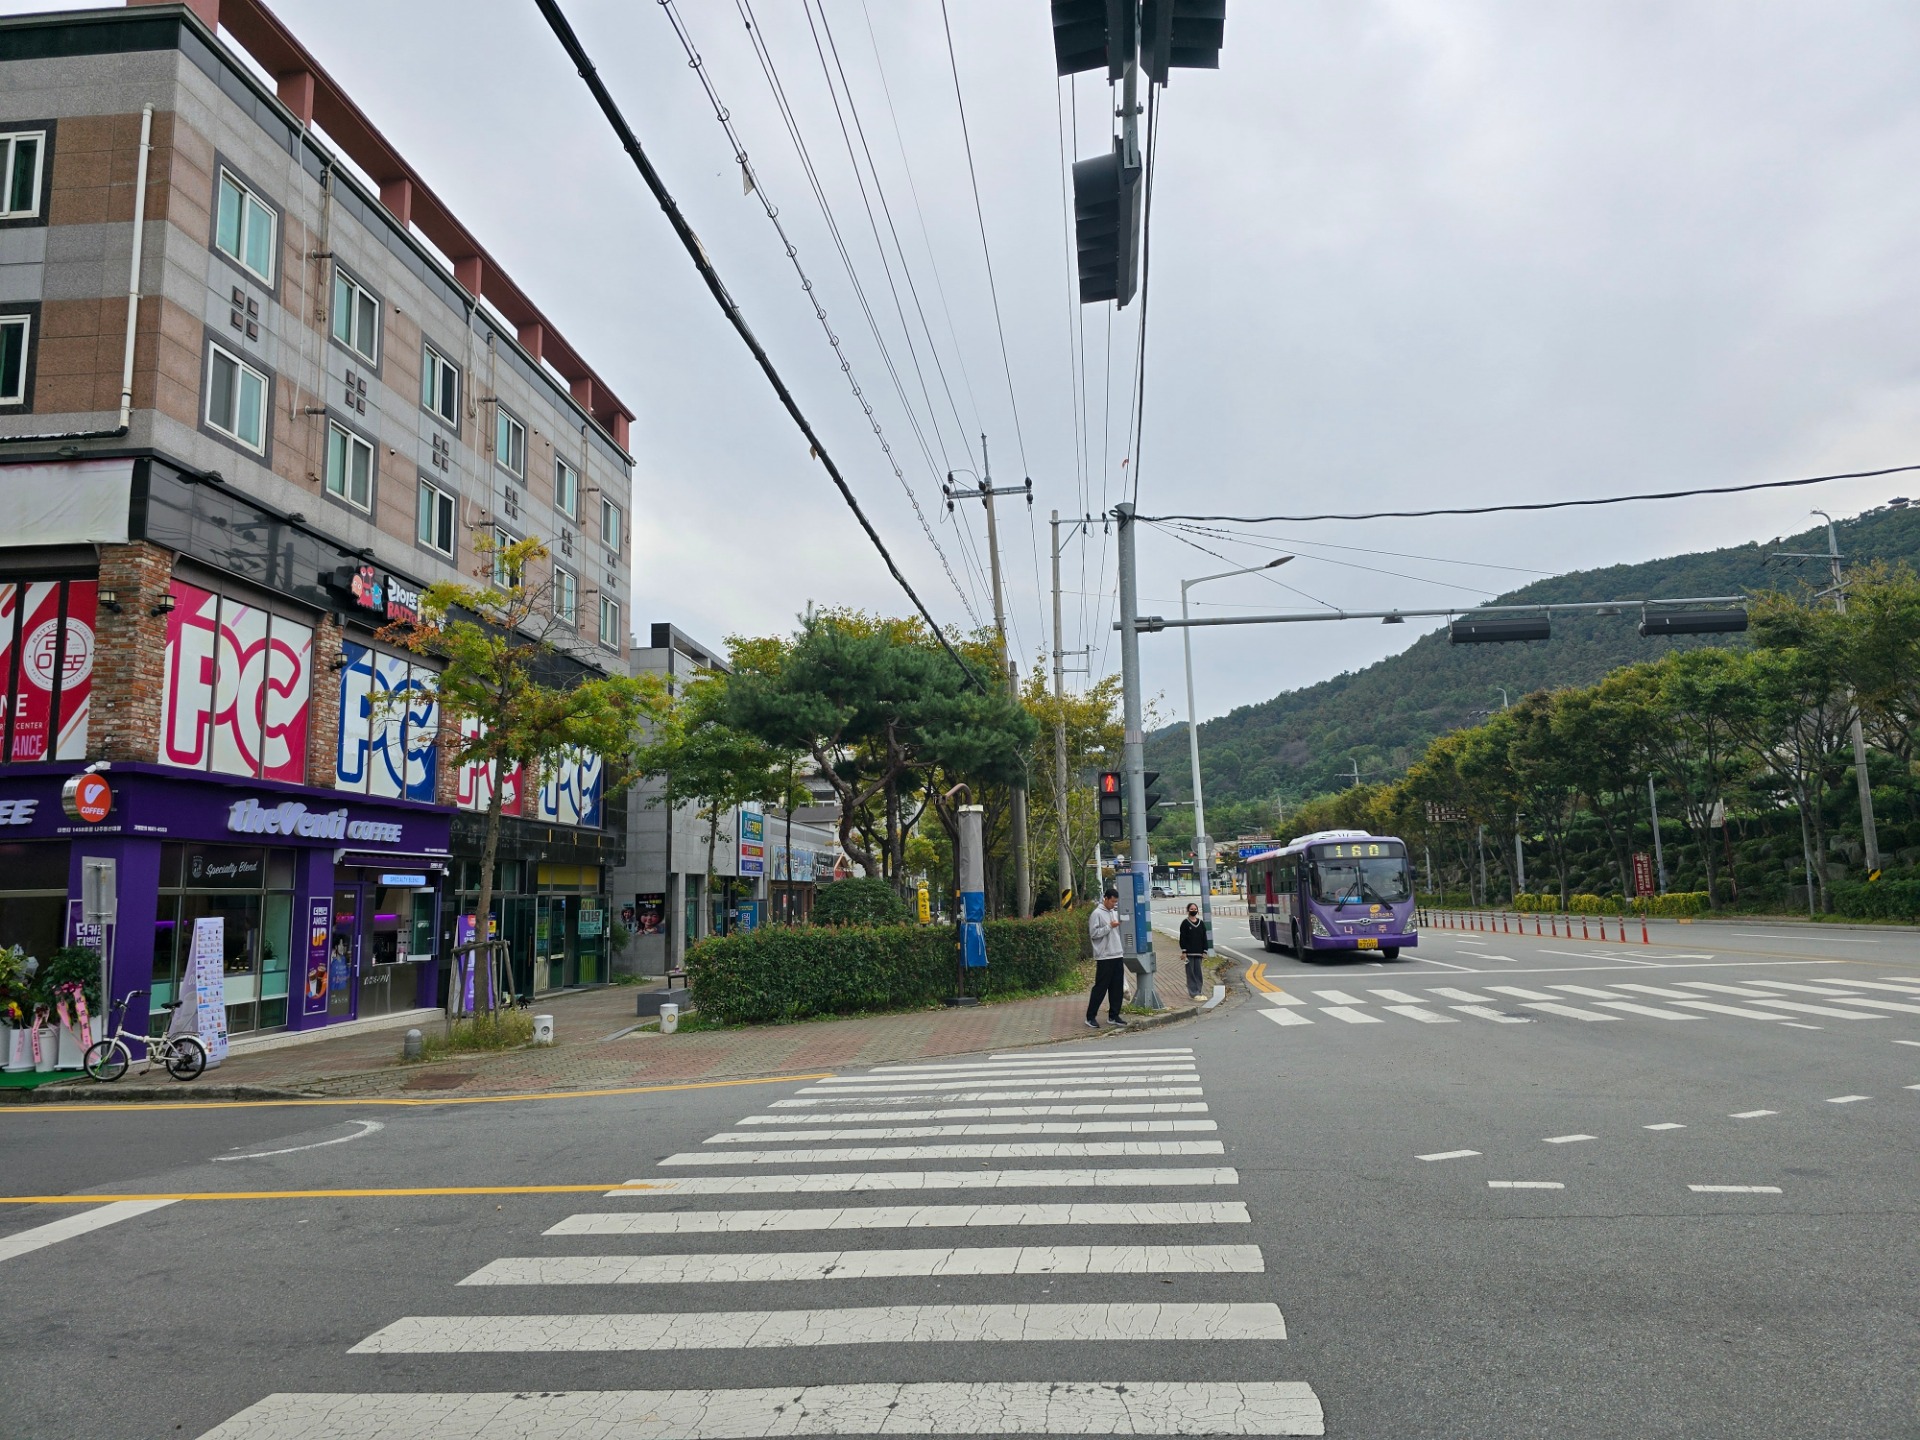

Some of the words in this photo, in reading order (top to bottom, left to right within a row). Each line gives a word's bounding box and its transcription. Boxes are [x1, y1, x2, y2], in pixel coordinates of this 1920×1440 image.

[388, 576, 417, 610] 라이또
[168, 617, 299, 769] PC
[15, 721, 43, 730] CENTER
[338, 665, 437, 789] PC
[81, 806, 106, 815] COFFEE
[228, 797, 349, 840] theVenti
[347, 820, 403, 842] COFFEE
[1335, 844, 1380, 858] 160
[205, 862, 238, 879] Specialty
[238, 859, 259, 873] Blend
[312, 927, 327, 947] UP
